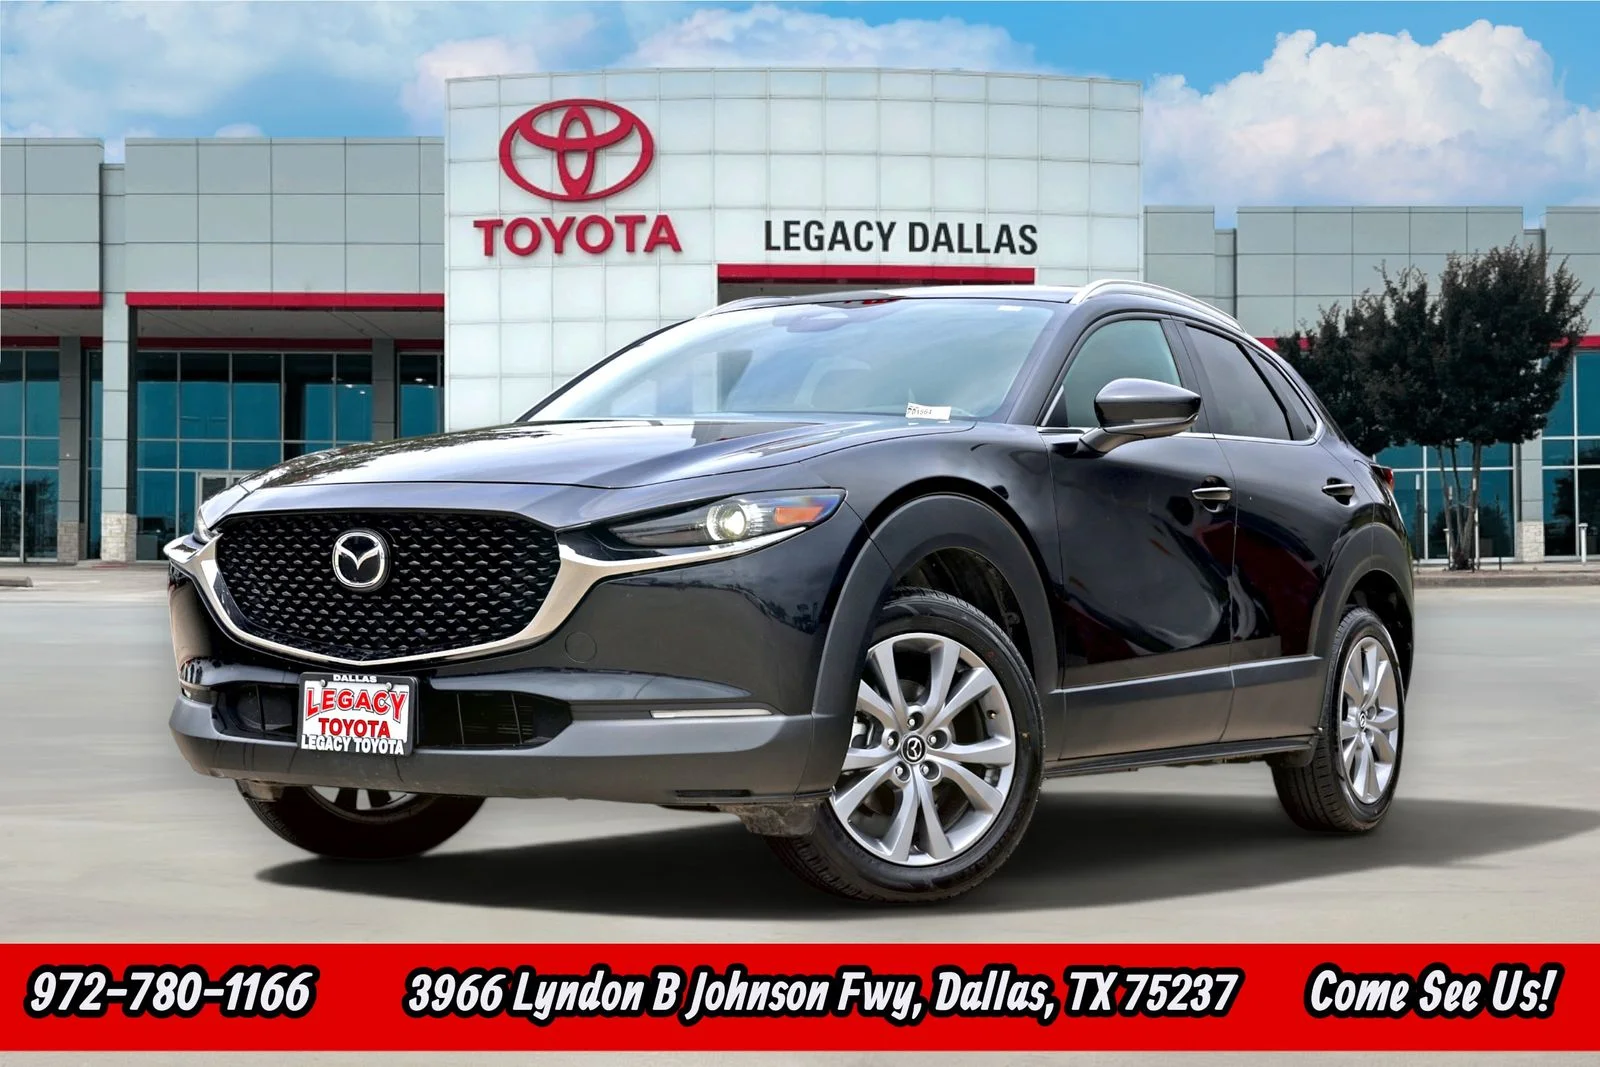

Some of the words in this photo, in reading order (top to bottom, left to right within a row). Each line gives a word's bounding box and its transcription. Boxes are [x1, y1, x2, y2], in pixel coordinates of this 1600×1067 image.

[473, 214, 682, 257] TOYOTA
[764, 219, 897, 252] LEGACY
[907, 221, 1038, 255] DALLAS
[332, 673, 378, 684] DALLAS
[305, 687, 409, 723] LEGACY
[318, 717, 391, 739] TOYOTA
[300, 733, 352, 753] LEGACY
[352, 736, 405, 755] TOYOTA
